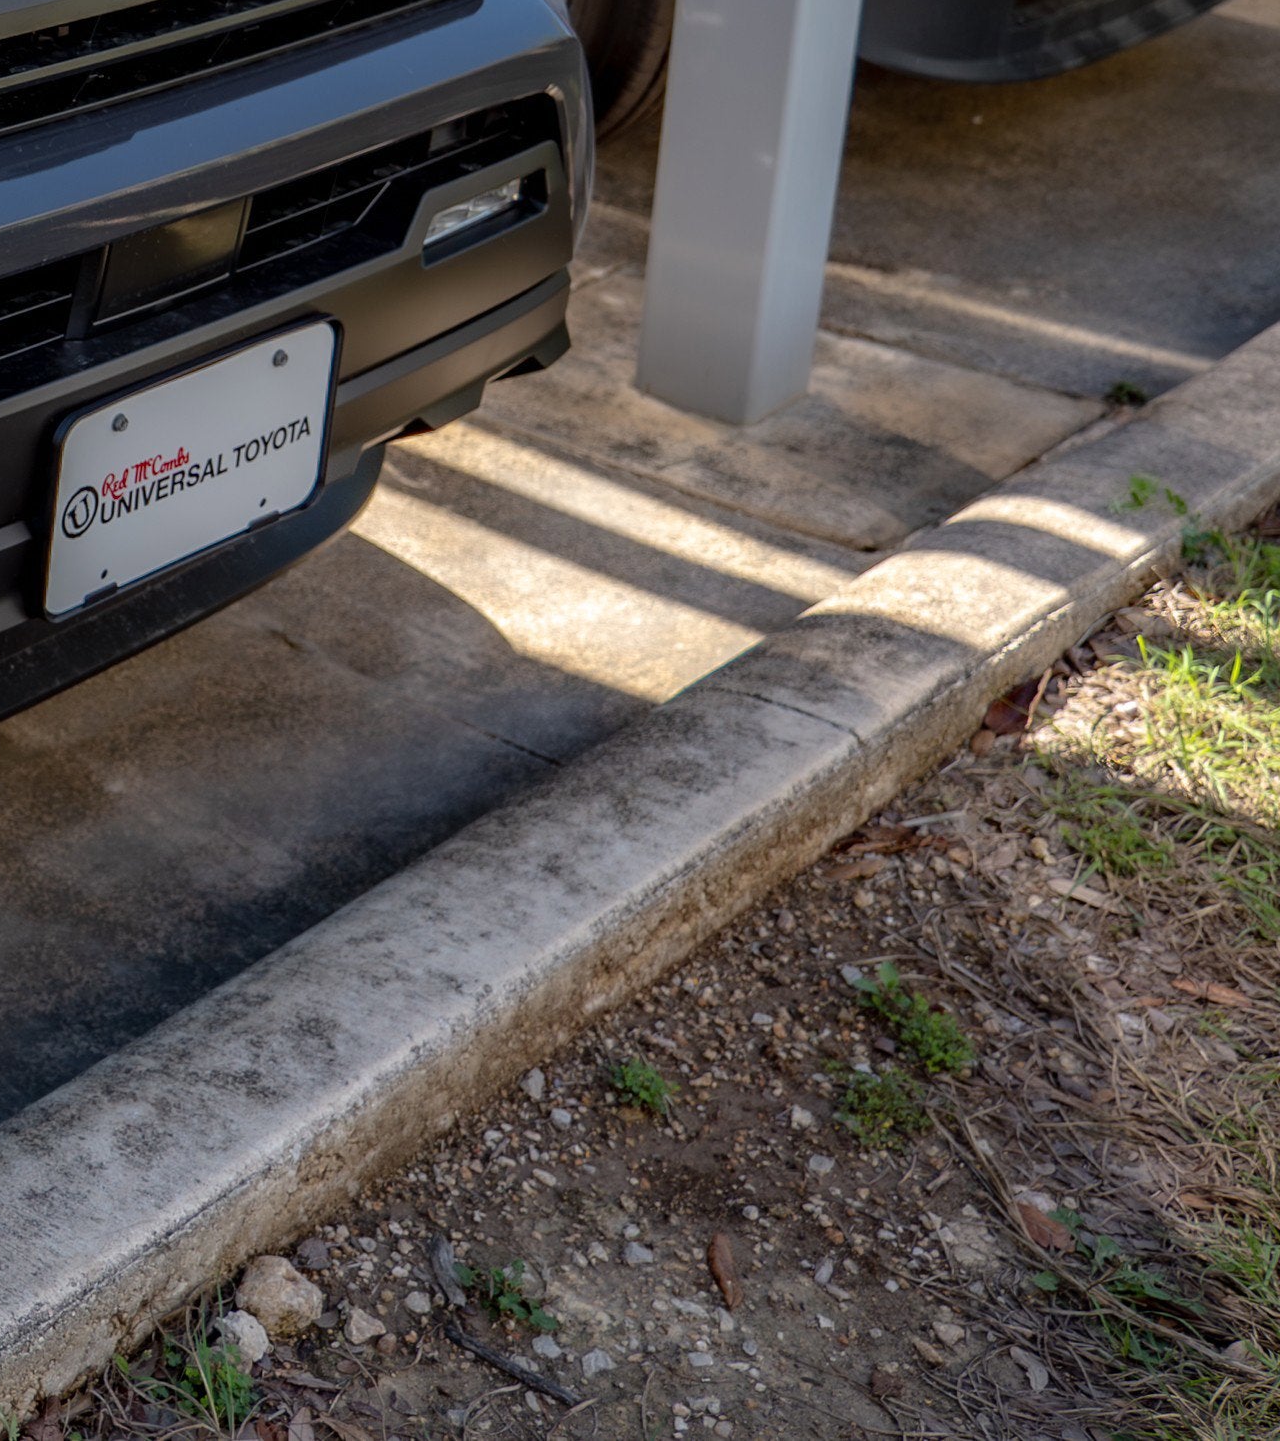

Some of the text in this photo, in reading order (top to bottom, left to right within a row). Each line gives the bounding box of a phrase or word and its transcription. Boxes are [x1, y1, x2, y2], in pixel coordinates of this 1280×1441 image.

[100, 416, 312, 524] UNIVERSAL TOYOTA
[101, 468, 128, 500] Red
